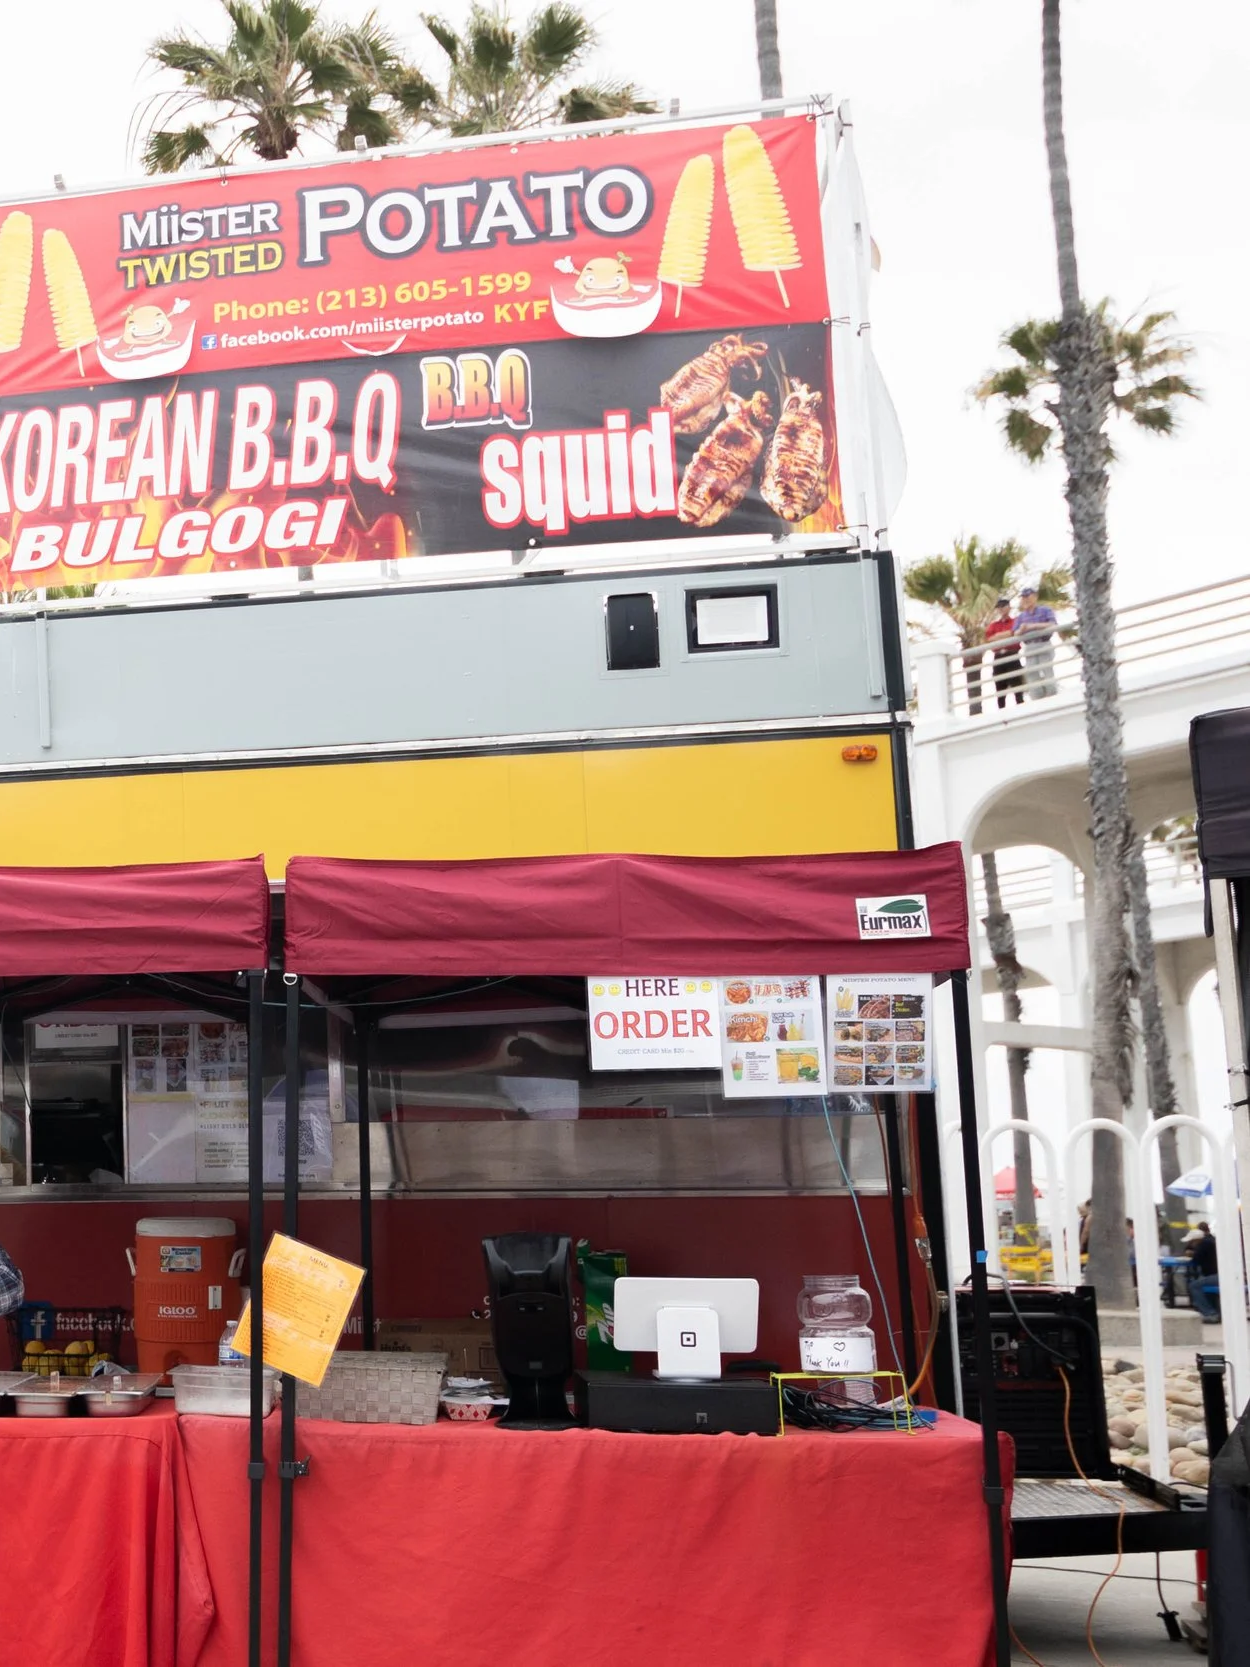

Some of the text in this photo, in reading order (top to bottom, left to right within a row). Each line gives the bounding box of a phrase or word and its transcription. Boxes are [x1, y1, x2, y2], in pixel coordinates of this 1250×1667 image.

[300, 165, 652, 266] POTATO
[118, 241, 283, 290] TWISTED
[213, 271, 532, 324] Phone: (213) 605-1599
[220, 309, 484, 349] facebook.com/miisterpotato
[420, 348, 533, 430] B.B.Q
[228, 370, 400, 493] B.B.Q
[480, 408, 678, 535] squid
[10, 498, 347, 573] BULGOGI
[859, 914, 923, 930] Eurmax
[625, 978, 680, 998] HERE
[593, 1009, 713, 1040] ORDER
[727, 1014, 759, 1024] Kimchi
[159, 1305, 197, 1315] IGLOO
